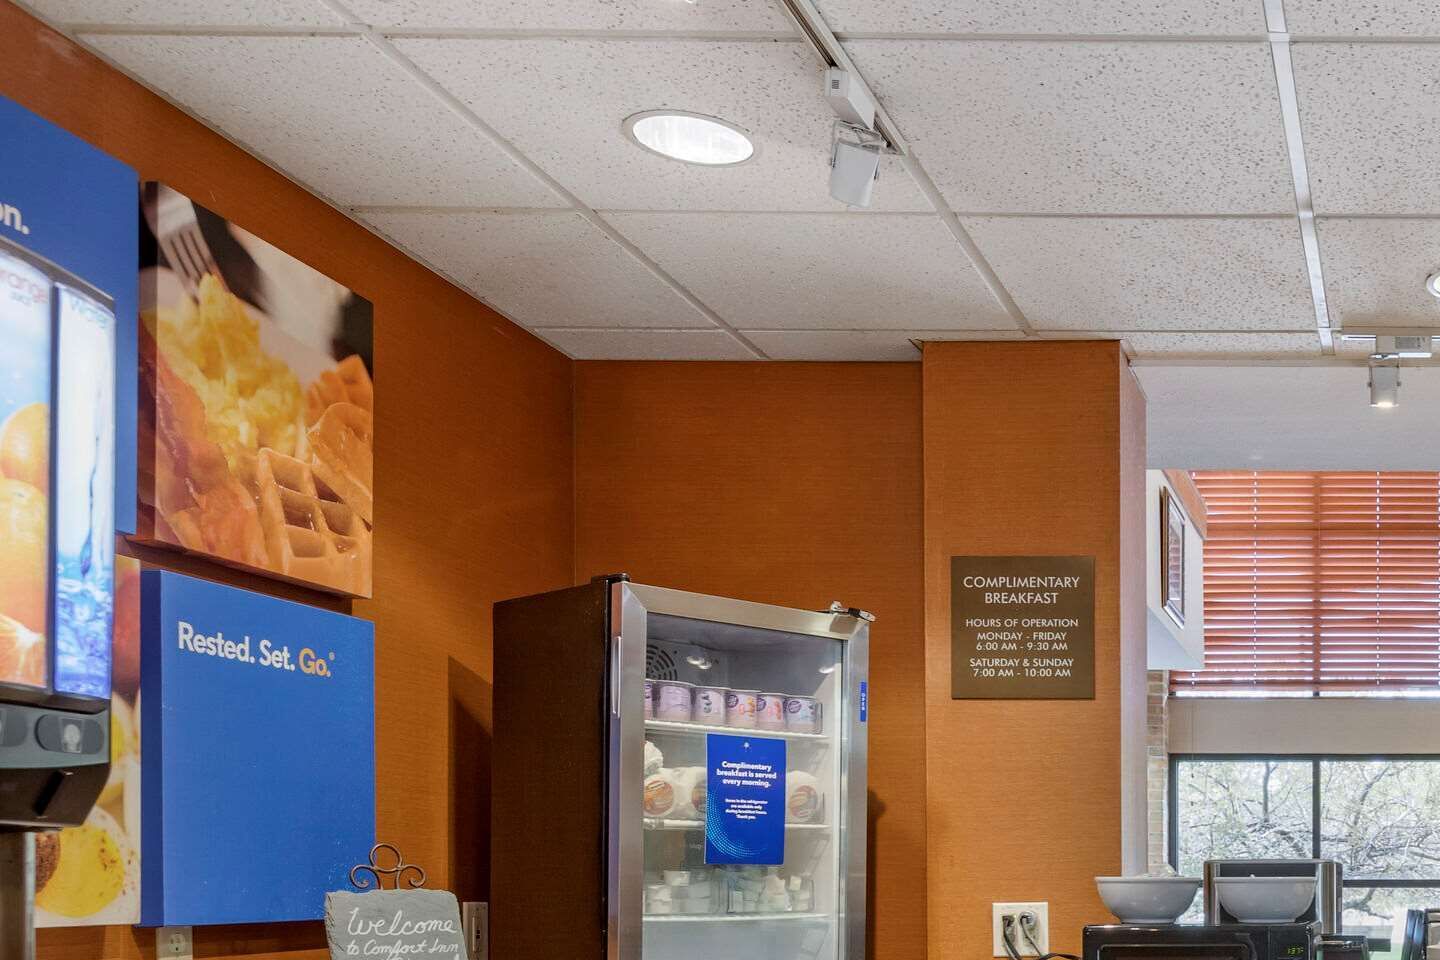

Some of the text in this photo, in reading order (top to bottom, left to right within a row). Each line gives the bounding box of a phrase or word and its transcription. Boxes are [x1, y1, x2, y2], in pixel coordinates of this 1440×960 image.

[0, 202, 30, 235] n.
[963, 576, 1080, 588] COMPLIMENTARY
[985, 592, 1059, 604] BREAKFAST
[965, 619, 1079, 627] HOURS OF OPERATION
[976, 632, 1023, 641] MONDAY
[1033, 632, 1067, 641] FRIDAY
[178, 621, 255, 664] Rested.
[259, 639, 295, 672] Set.
[975, 642, 998, 651] 6:00
[1001, 642, 1017, 651] AM
[1026, 642, 1049, 651] 9:30
[1052, 642, 1068, 651] AM
[969, 658, 1074, 667] SATURDAY & SUNDAY
[973, 668, 995, 677] 7:00
[998, 668, 1014, 677] AM
[1024, 668, 1052, 677] 10:00
[1054, 668, 1071, 677] AM
[722, 761, 772, 772] Complimentary
[716, 769, 748, 777] breakfast
[755, 771, 777, 779] served
[723, 779, 741, 787] every
[348, 907, 457, 935] Welcome
[347, 940, 359, 955] to
[427, 938, 459, 953] Inn
